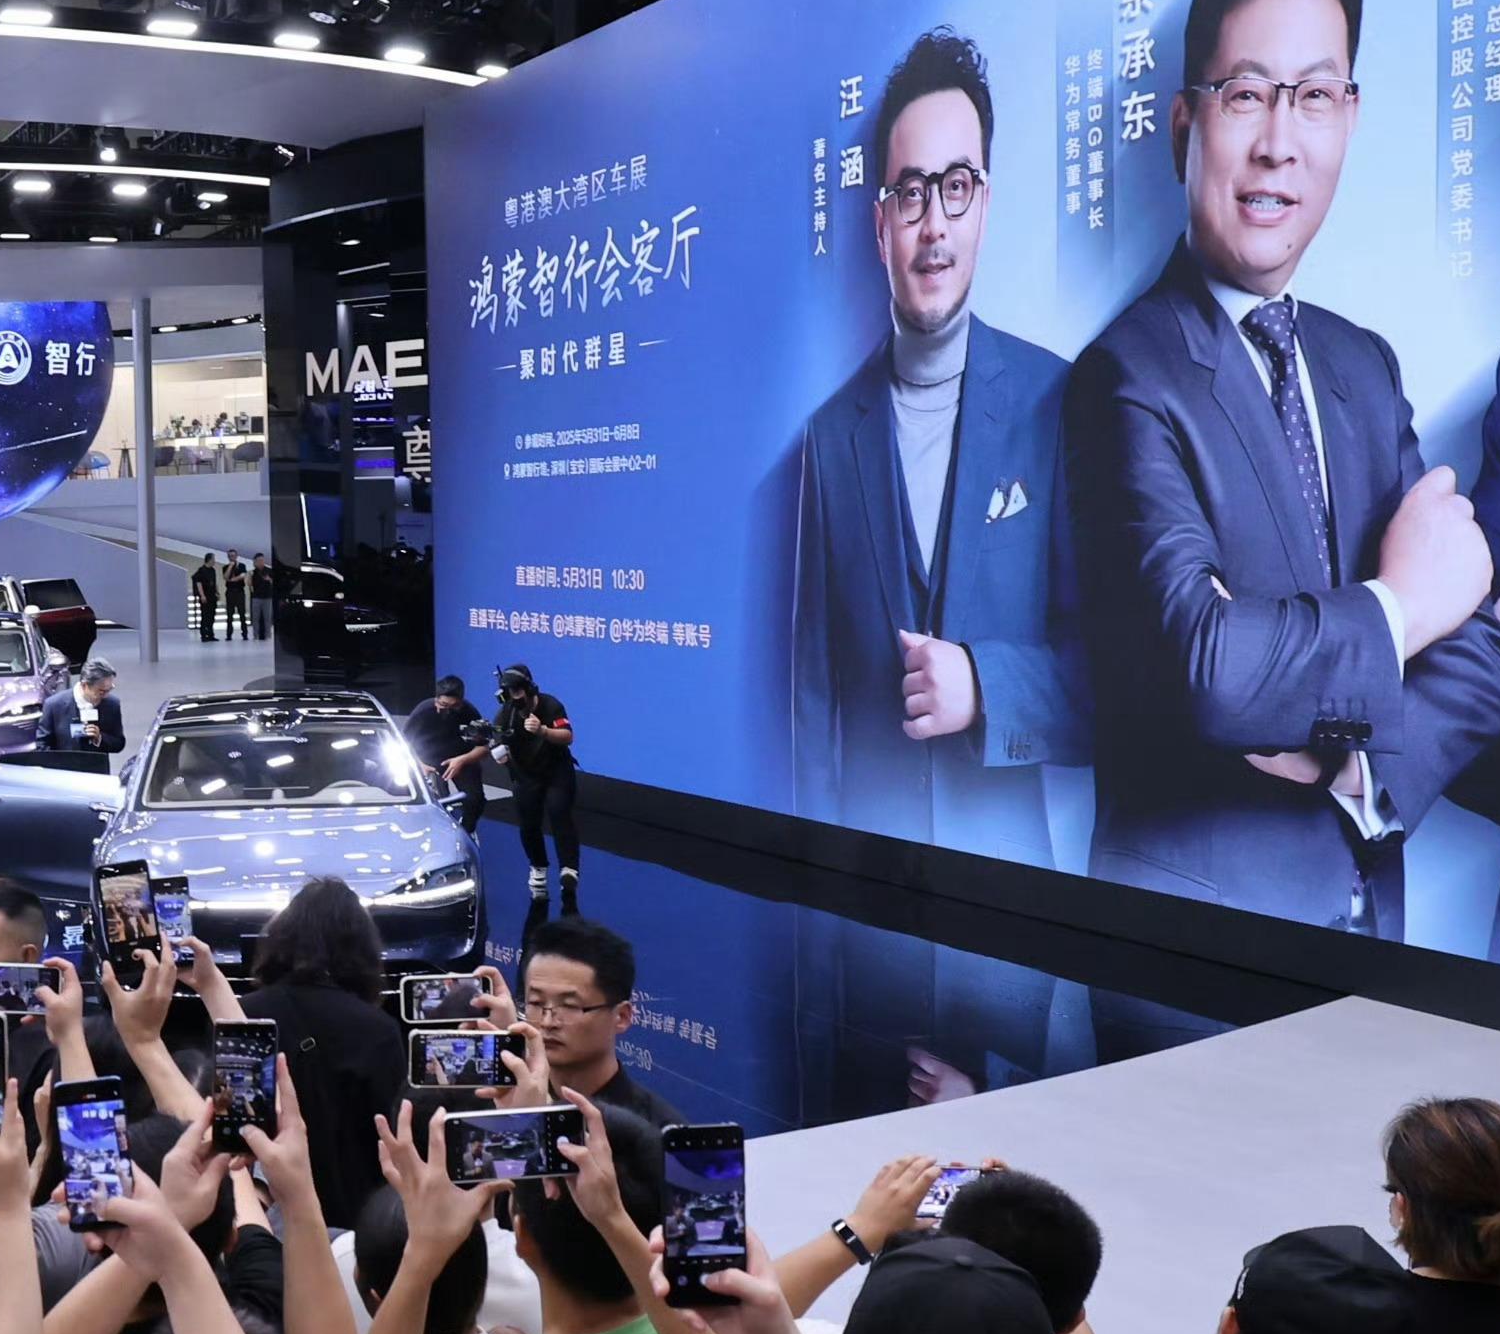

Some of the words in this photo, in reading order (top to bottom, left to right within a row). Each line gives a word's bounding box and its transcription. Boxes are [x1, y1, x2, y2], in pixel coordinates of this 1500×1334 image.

[840, 75, 864, 189] 汪涵
[1064, 55, 1081, 216] 华为常务董事
[1087, 48, 1104, 229] 终端BG董事长
[504, 154, 648, 228] 粤港澳大湾区车展
[813, 138, 826, 256] 著名主持人
[469, 205, 700, 334] 鸿蒙智行会客厅
[46, 340, 96, 377] 智行
[520, 332, 626, 380] 聚时代群星
[612, 569, 645, 590] 10:30
[553, 614, 606, 639] @鸿蒙智行
[610, 618, 669, 644] @华为终端
[672, 622, 711, 648] 等账号
